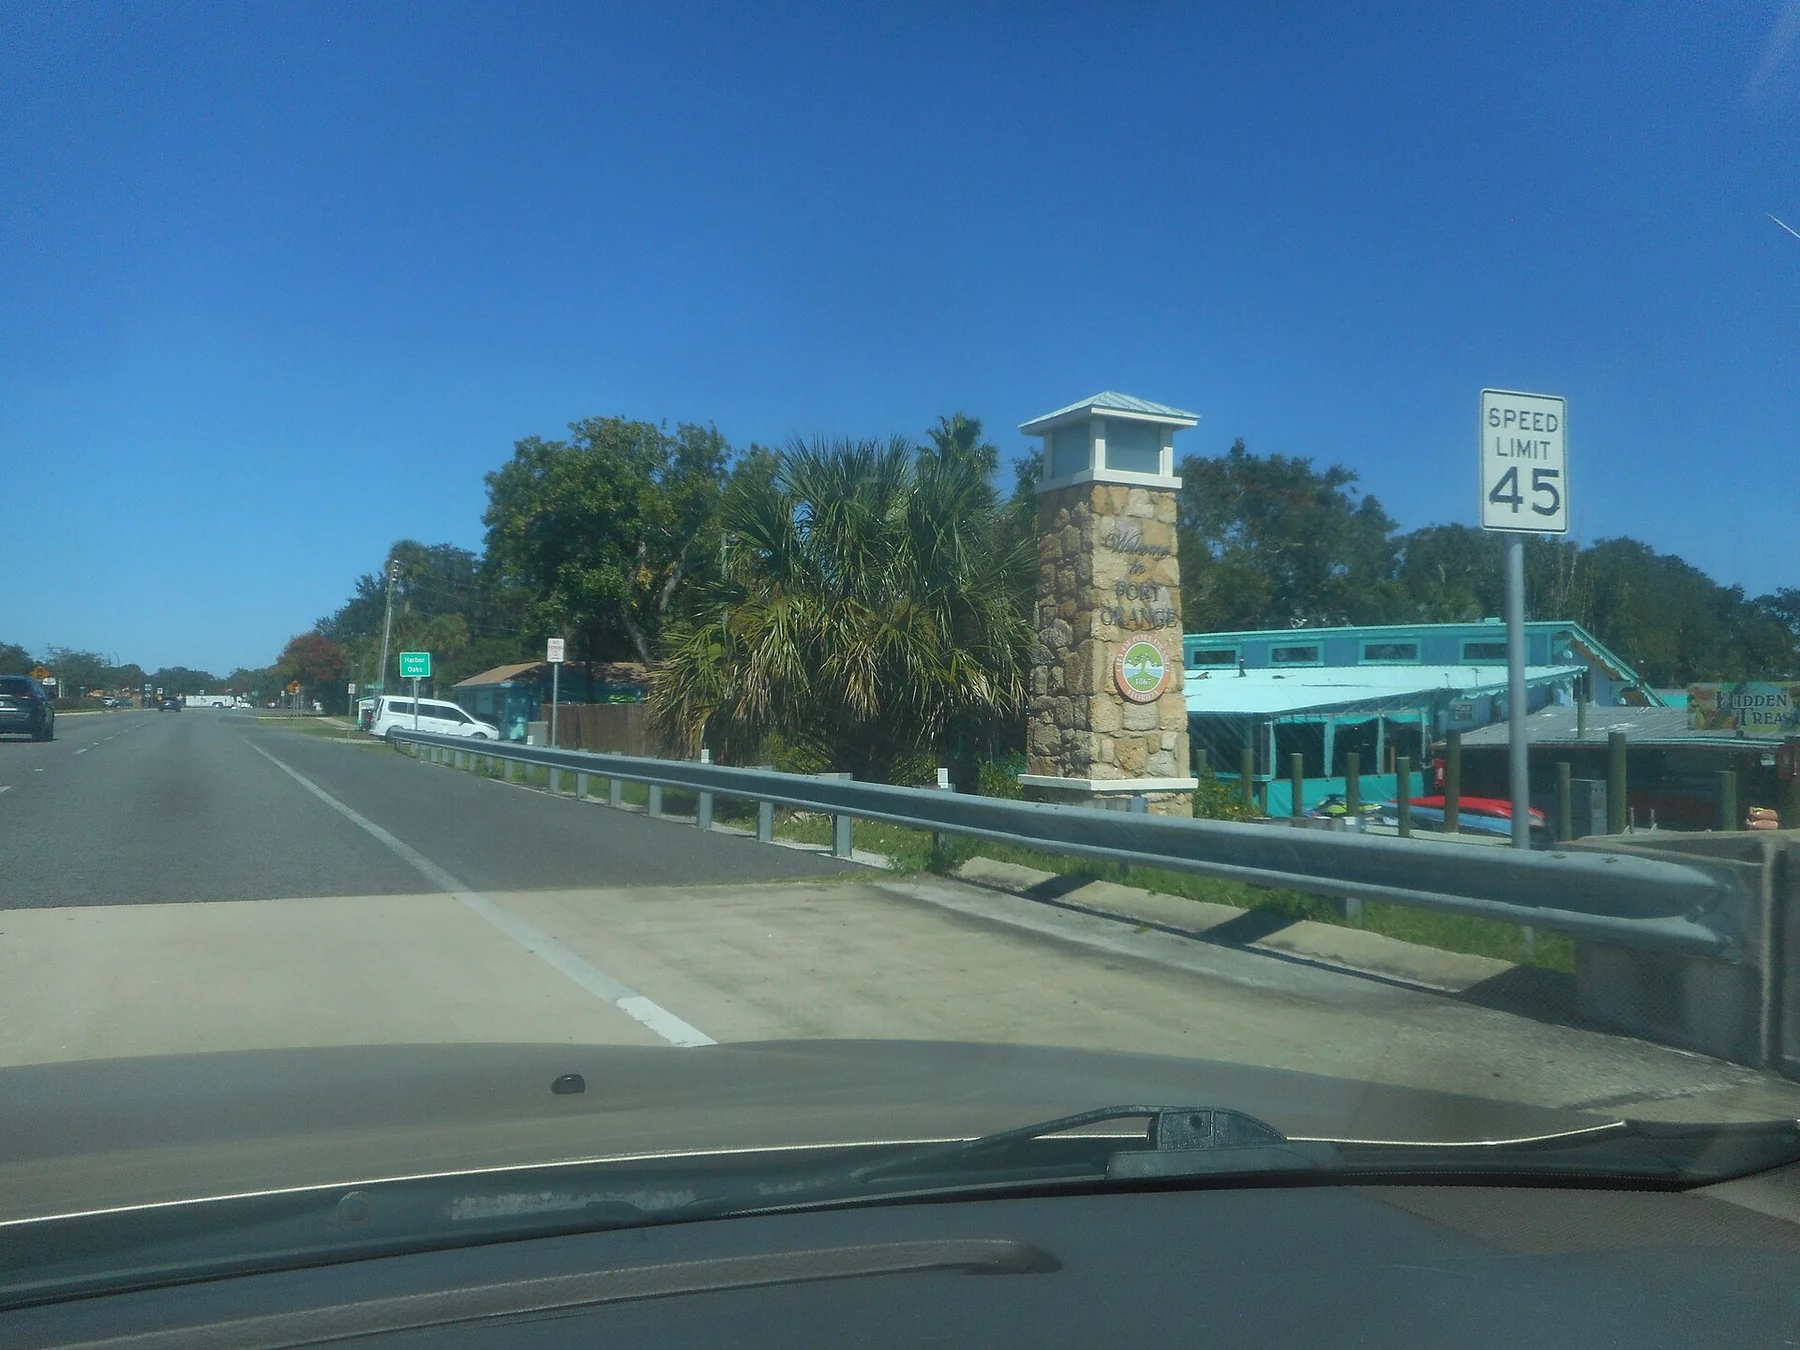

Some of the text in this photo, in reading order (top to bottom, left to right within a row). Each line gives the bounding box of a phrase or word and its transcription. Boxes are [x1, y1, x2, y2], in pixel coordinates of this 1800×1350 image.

[1488, 407, 1558, 433] SPEED
[1496, 437, 1551, 460] LIMIT
[1488, 466, 1561, 517] 45
[1116, 579, 1158, 601] PORT
[1101, 604, 1177, 628] ORANGE
[1716, 691, 1787, 709] HIDDEN
